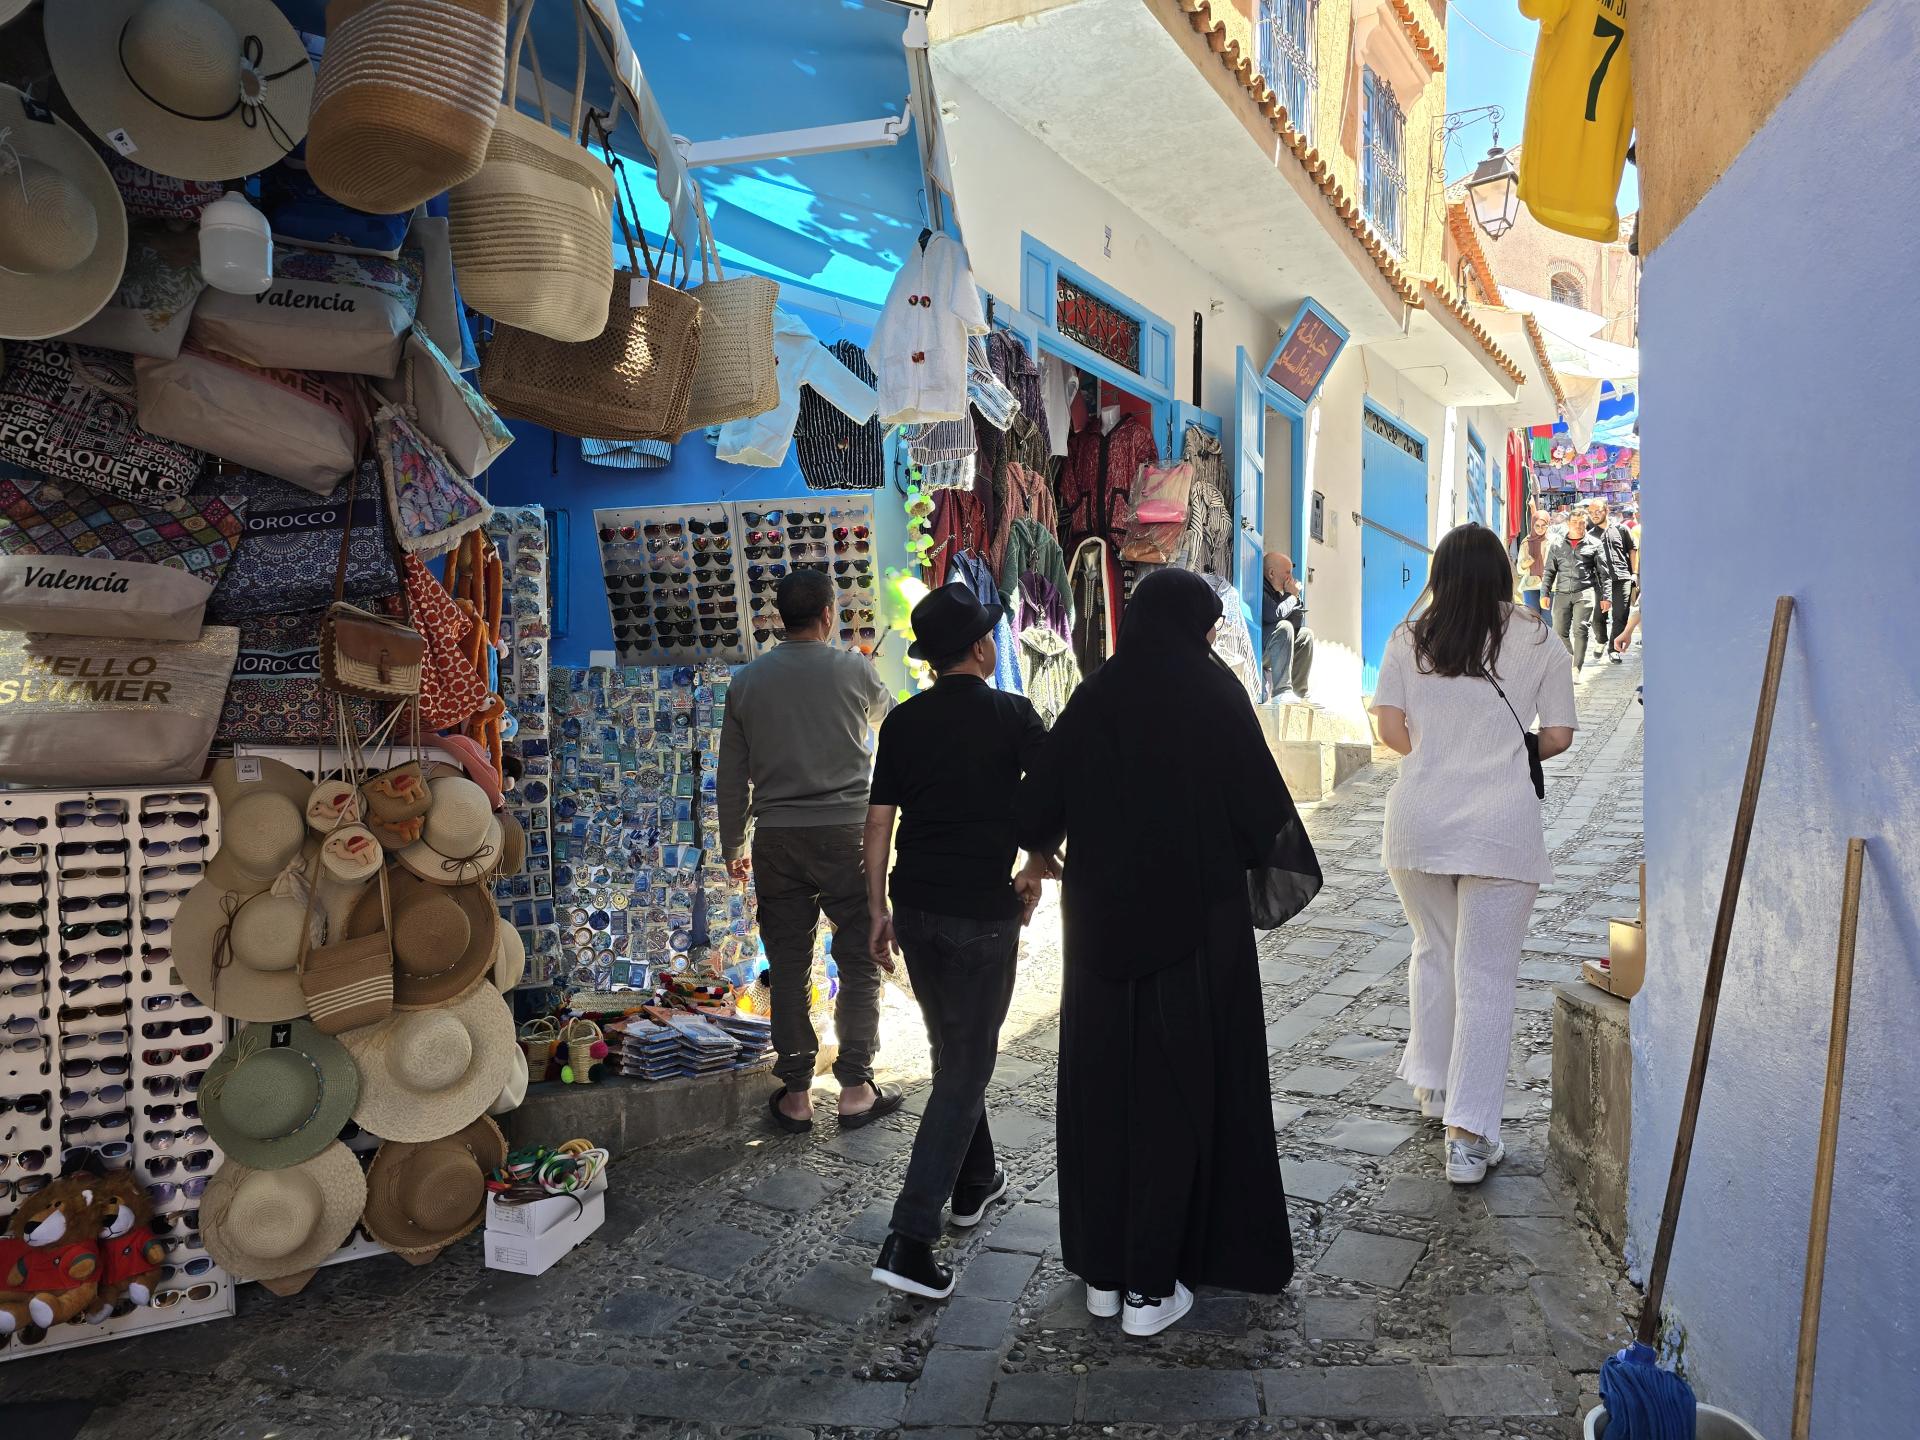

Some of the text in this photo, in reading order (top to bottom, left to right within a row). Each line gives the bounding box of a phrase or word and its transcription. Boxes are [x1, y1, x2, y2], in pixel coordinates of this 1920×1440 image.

[1585, 14, 1624, 122] 7
[1105, 234, 1111, 248] 7
[256, 287, 356, 312] Valencia
[0, 423, 150, 486] FCHAOUEN
[37, 455, 132, 491] CHEFCHAOUEN
[246, 511, 336, 530] OROCCO
[24, 566, 129, 593] Valencia
[17, 656, 157, 677] HELLO
[236, 655, 320, 672] OROCCO
[0, 679, 172, 704] SUMMER
